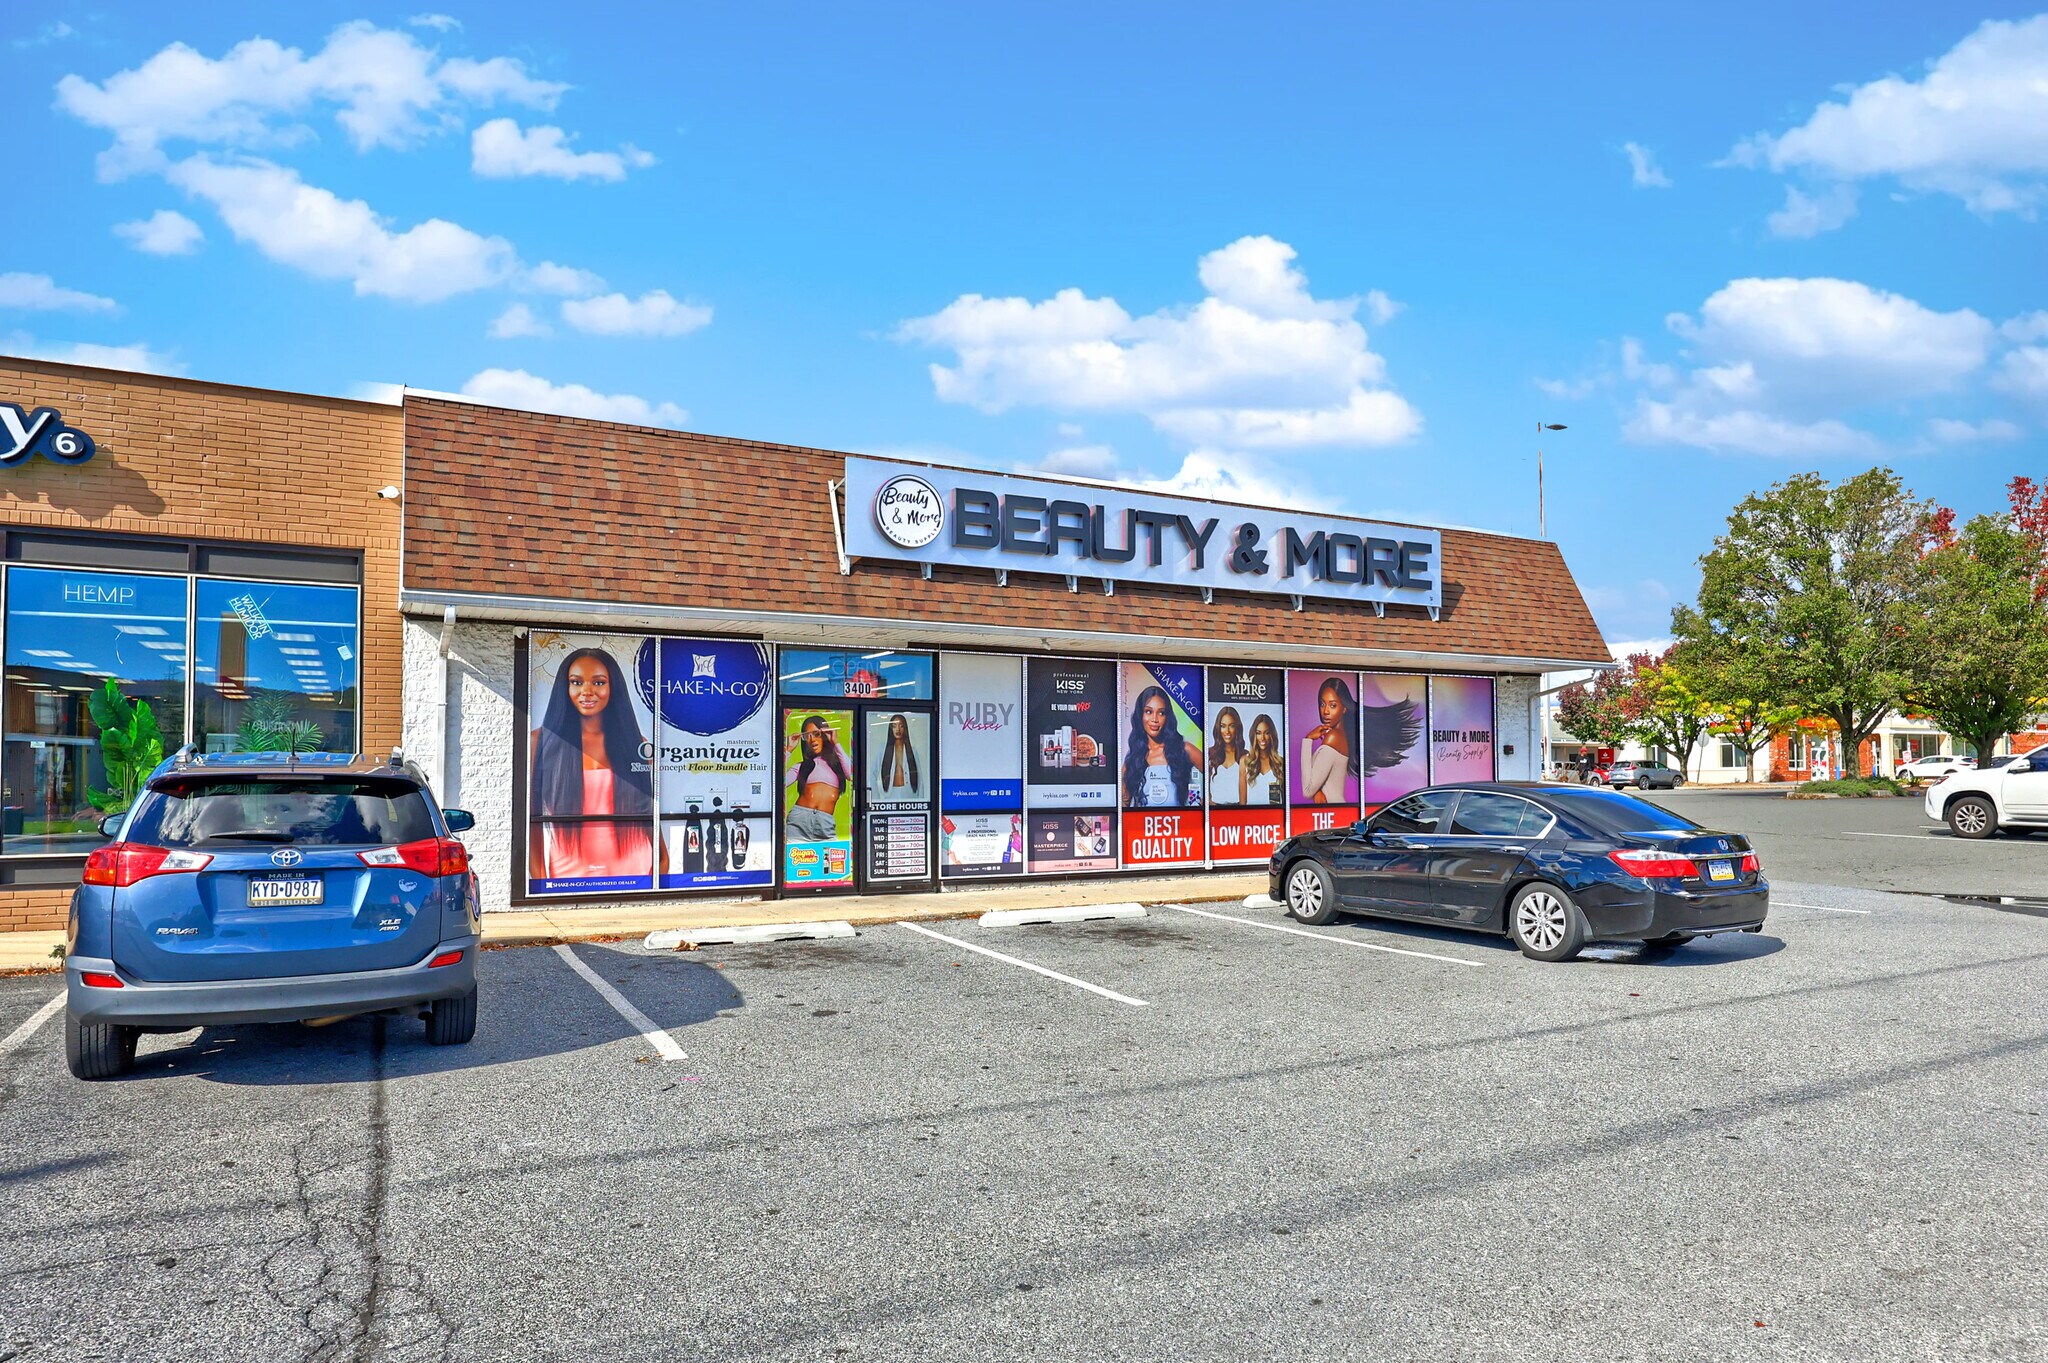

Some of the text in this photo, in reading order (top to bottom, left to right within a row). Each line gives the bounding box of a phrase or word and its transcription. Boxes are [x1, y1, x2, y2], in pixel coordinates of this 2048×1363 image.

[56, 432, 77, 454] 6
[883, 487, 929, 509] Beauty
[892, 507, 941, 526] & More
[885, 526, 938, 544] BEAUTY SUPPLY
[951, 487, 1433, 591] BEAUTY & MORE
[64, 584, 135, 604] HEMP
[230, 597, 263, 640] HUMIDOR
[241, 594, 271, 635] WALK-IN
[646, 678, 763, 698] SHAKE-N-GO
[845, 682, 871, 695] 3400
[1056, 680, 1085, 690] KISS
[1154, 666, 1199, 716] SHAKE-N-GO
[948, 701, 1014, 727] RUBY
[961, 716, 1003, 732] Kisses
[1433, 730, 1490, 743] BEAUTY & MORE
[638, 742, 759, 763] Organique
[1437, 746, 1462, 762] Beauty
[631, 762, 651, 772] New
[657, 764, 687, 773] oncept
[688, 763, 714, 771] Floor
[716, 763, 748, 771] Bundle
[871, 803, 897, 811] STORE
[1145, 816, 1180, 837] BEST
[1312, 812, 1335, 829] THE
[1212, 825, 1281, 846] LOW PRICE
[1132, 837, 1193, 859] QUALITY
[156, 927, 199, 935] RAV4
[379, 918, 402, 926] XLE
